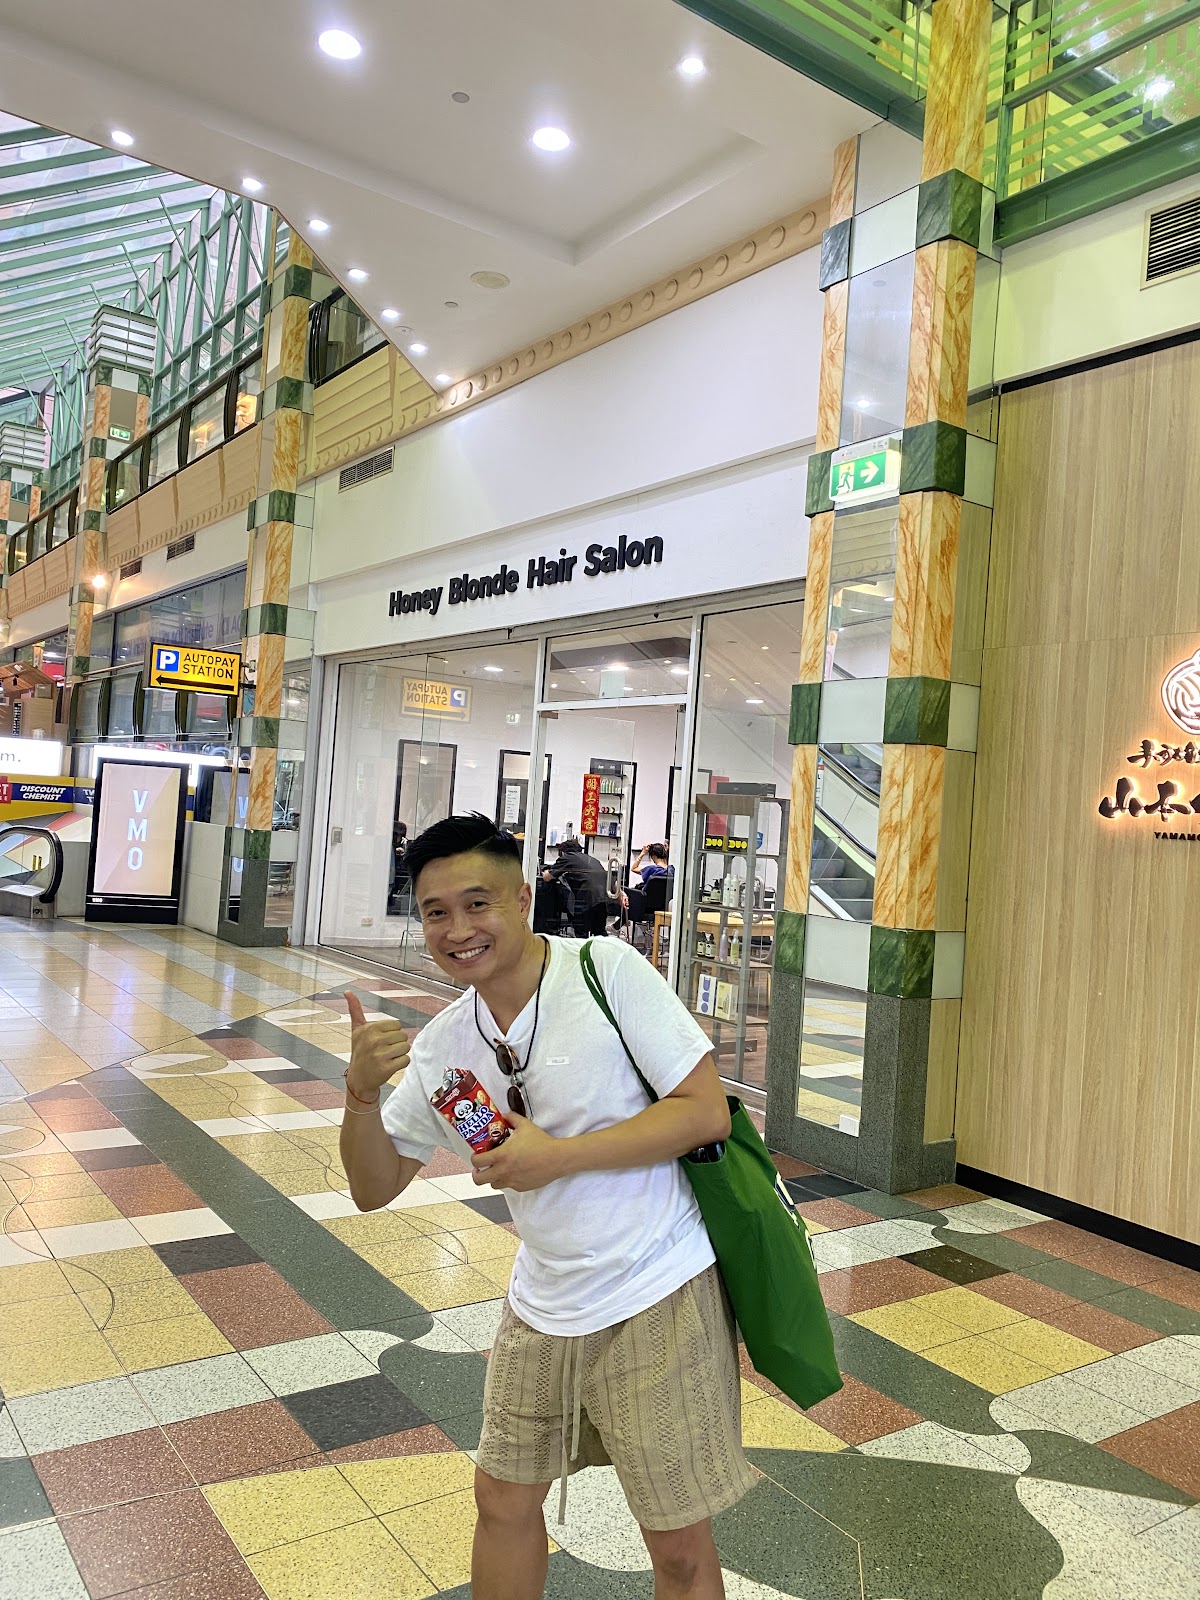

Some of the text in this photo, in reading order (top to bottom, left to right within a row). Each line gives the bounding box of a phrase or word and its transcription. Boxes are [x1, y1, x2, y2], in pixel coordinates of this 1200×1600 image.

[388, 535, 664, 616] Honey Blonde Hair Salon
[159, 650, 176, 670] P
[183, 653, 236, 668] AUTOPAY
[182, 664, 233, 679] STATION
[20, 785, 66, 794] DISCOUNT
[22, 793, 61, 801] CHEMIST
[127, 789, 149, 871] VMO
[458, 1106, 488, 1132] HELLO
[462, 1112, 494, 1138] PANDA
